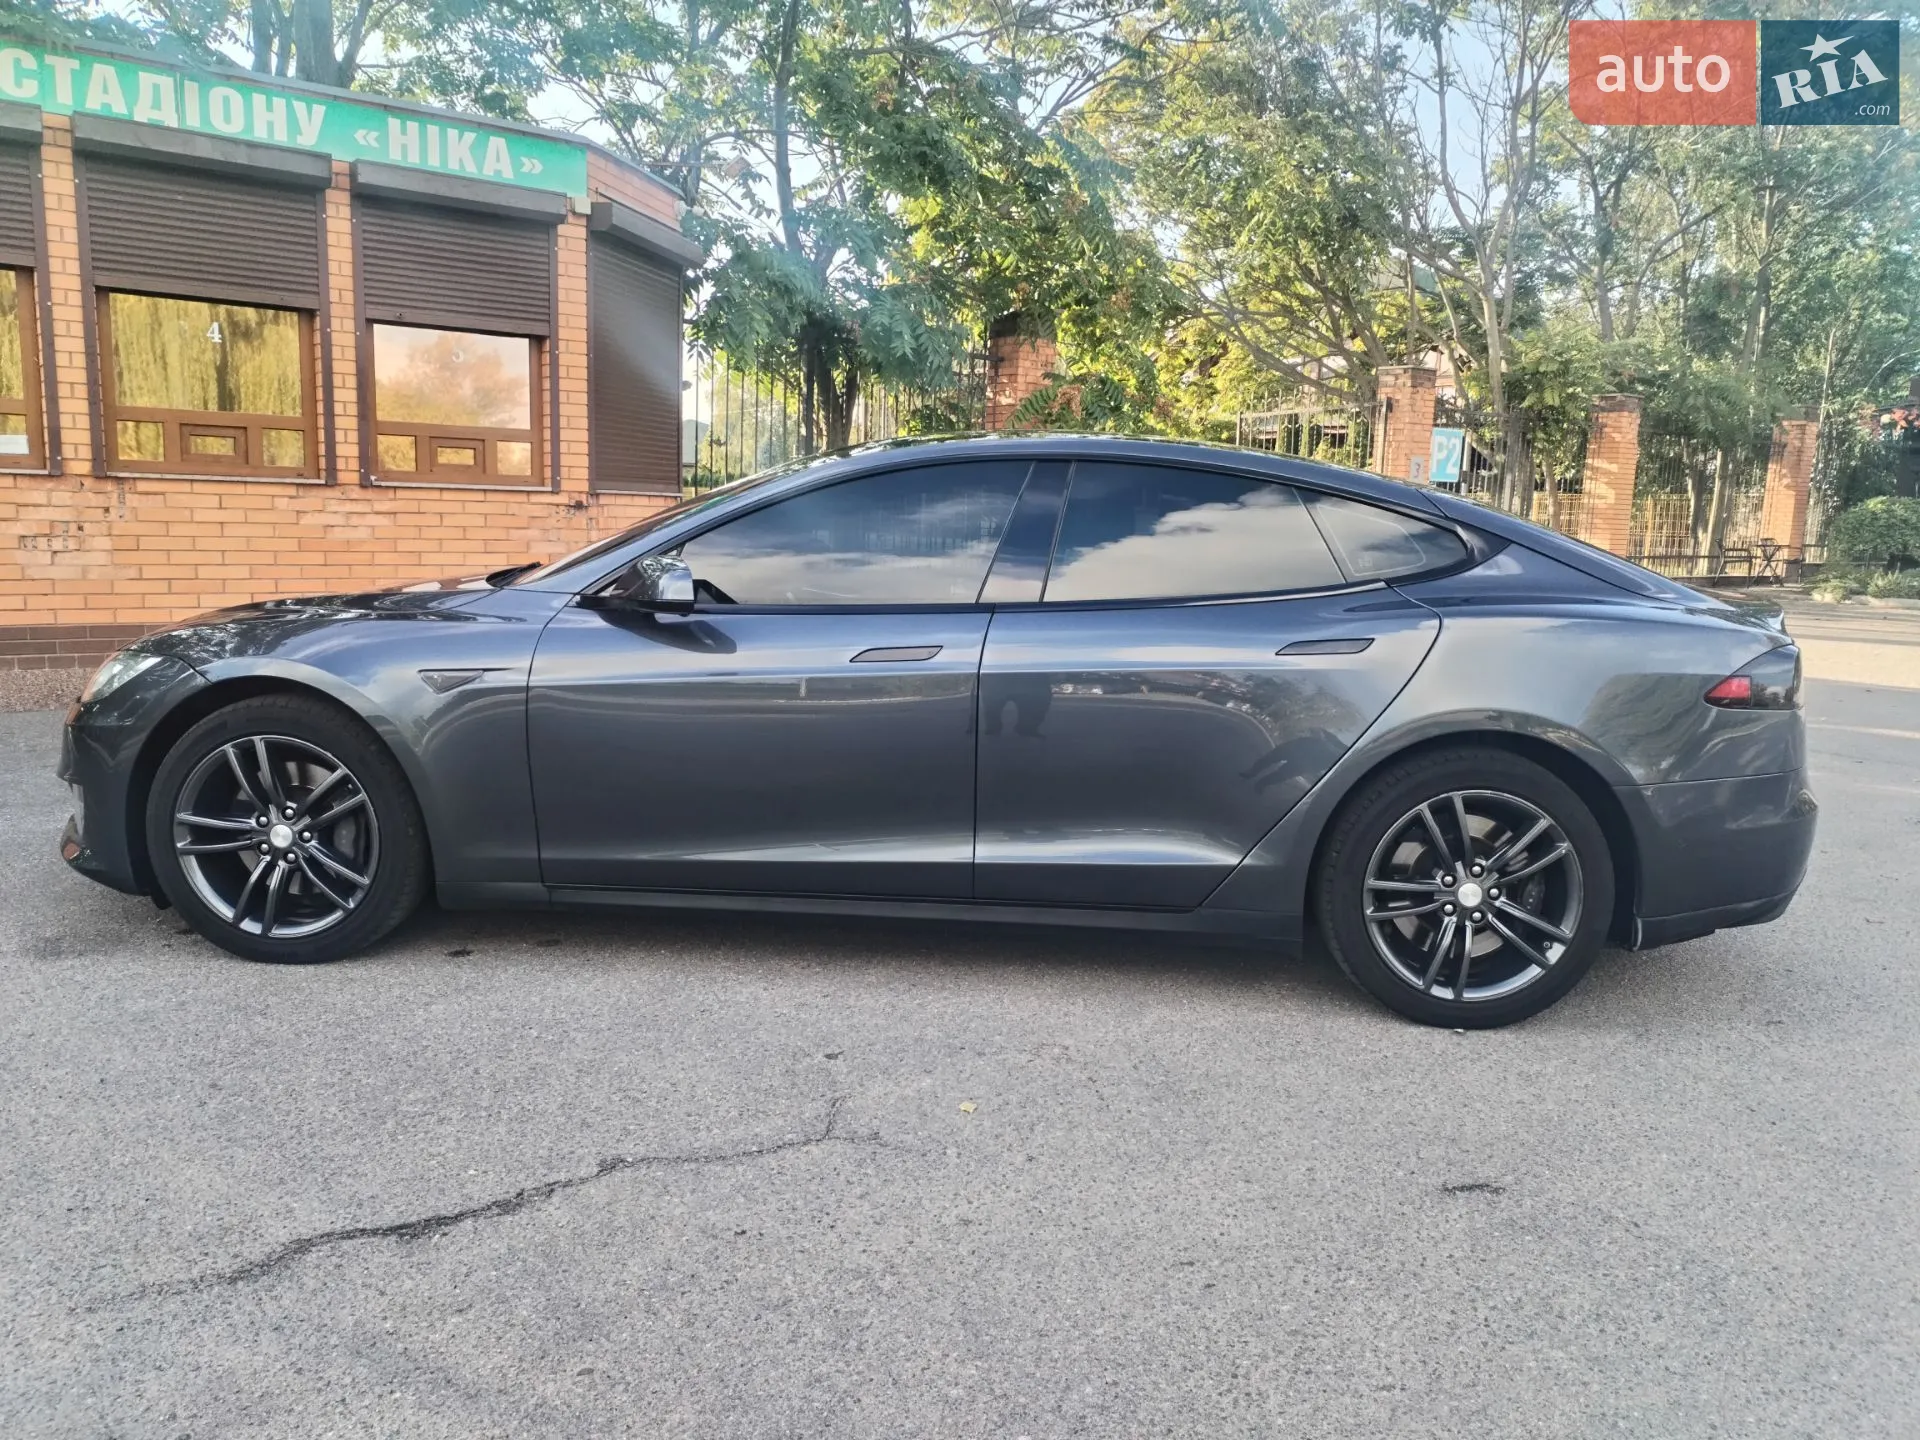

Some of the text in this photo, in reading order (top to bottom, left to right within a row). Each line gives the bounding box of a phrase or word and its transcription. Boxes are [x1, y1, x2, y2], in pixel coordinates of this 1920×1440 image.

[0, 47, 544, 179] СТАДІОНУ «НІКА»
[206, 321, 223, 343] 4
[1433, 435, 1460, 474] P2
